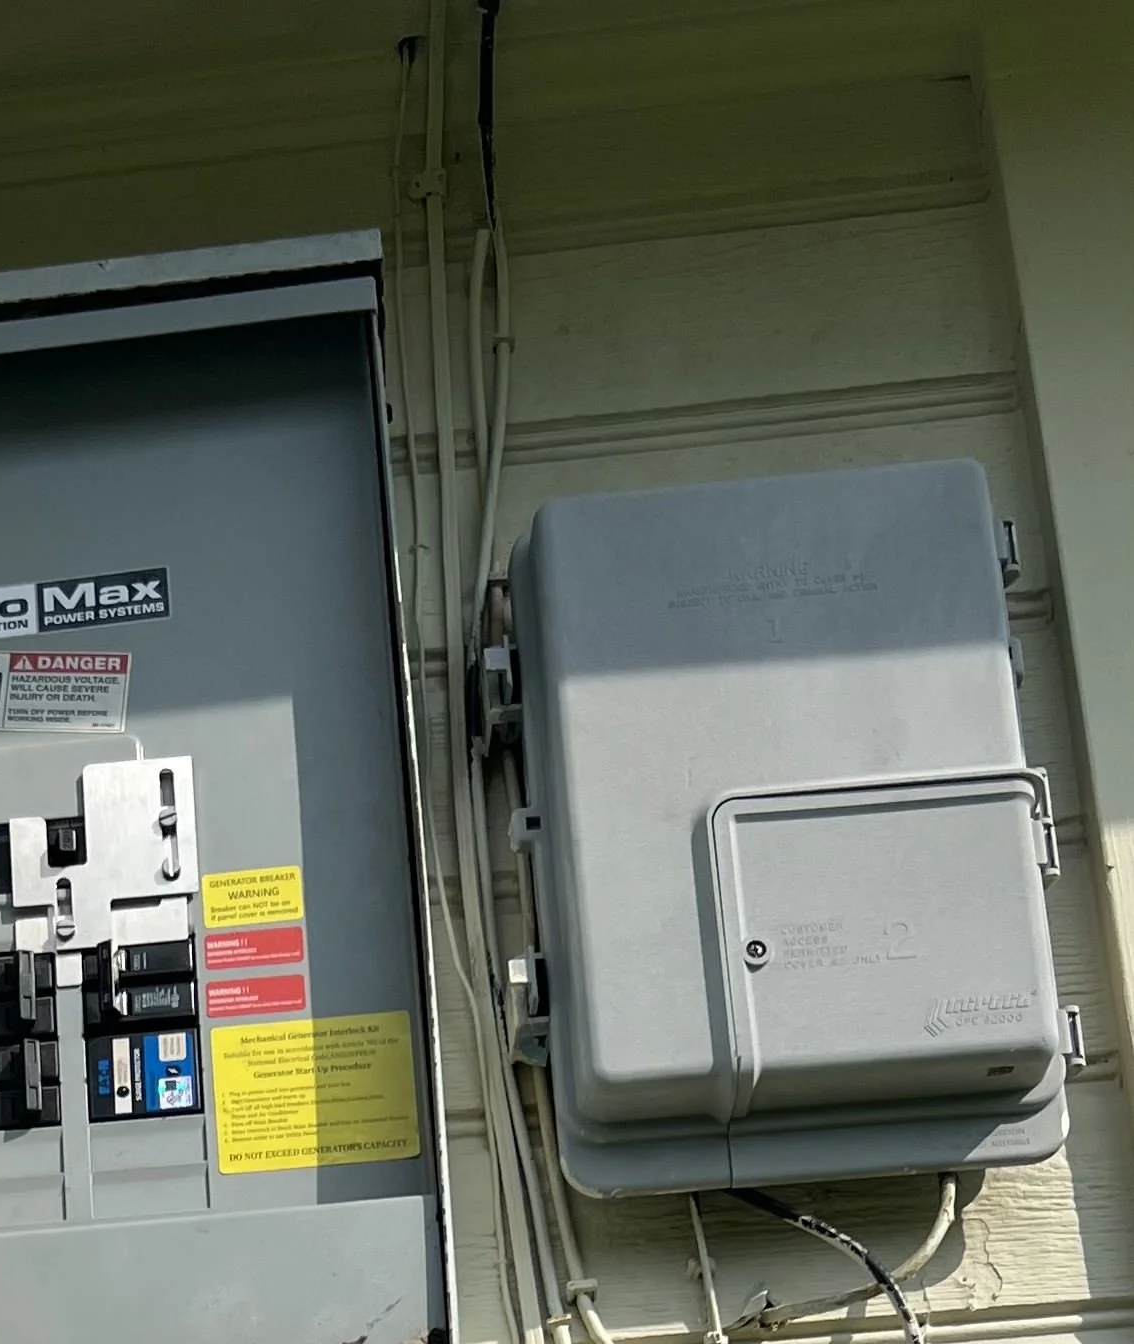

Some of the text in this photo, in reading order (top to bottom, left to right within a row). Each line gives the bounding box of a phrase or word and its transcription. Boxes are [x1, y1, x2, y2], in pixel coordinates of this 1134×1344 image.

[43, 579, 163, 613] Max
[44, 608, 95, 626] POWER
[99, 602, 165, 620] SYSTEMS
[37, 655, 121, 671] DANGER
[12, 675, 72, 684] HAZARDOUS
[10, 684, 110, 694] WILL CAUSE SEVERE
[9, 693, 44, 701] INJURY
[46, 694, 60, 702] OR
[209, 872, 296, 889] GENERATOR BREAKER
[228, 886, 280, 901] WARNING
[210, 904, 237, 914] Breaker
[253, 900, 269, 910] NOT
[270, 899, 280, 907] be
[217, 912, 237, 922] panel
[267, 906, 299, 916] removed
[241, 1025, 380, 1045] Mechanical Generator Interlock Kit
[253, 1069, 294, 1079] Generator
[330, 1061, 372, 1072] Procedure
[229, 1153, 243, 1162] DO
[244, 1151, 263, 1160] NOT
[265, 1148, 300, 1159] EXCEED
[363, 1138, 408, 1150] CAPACITY
